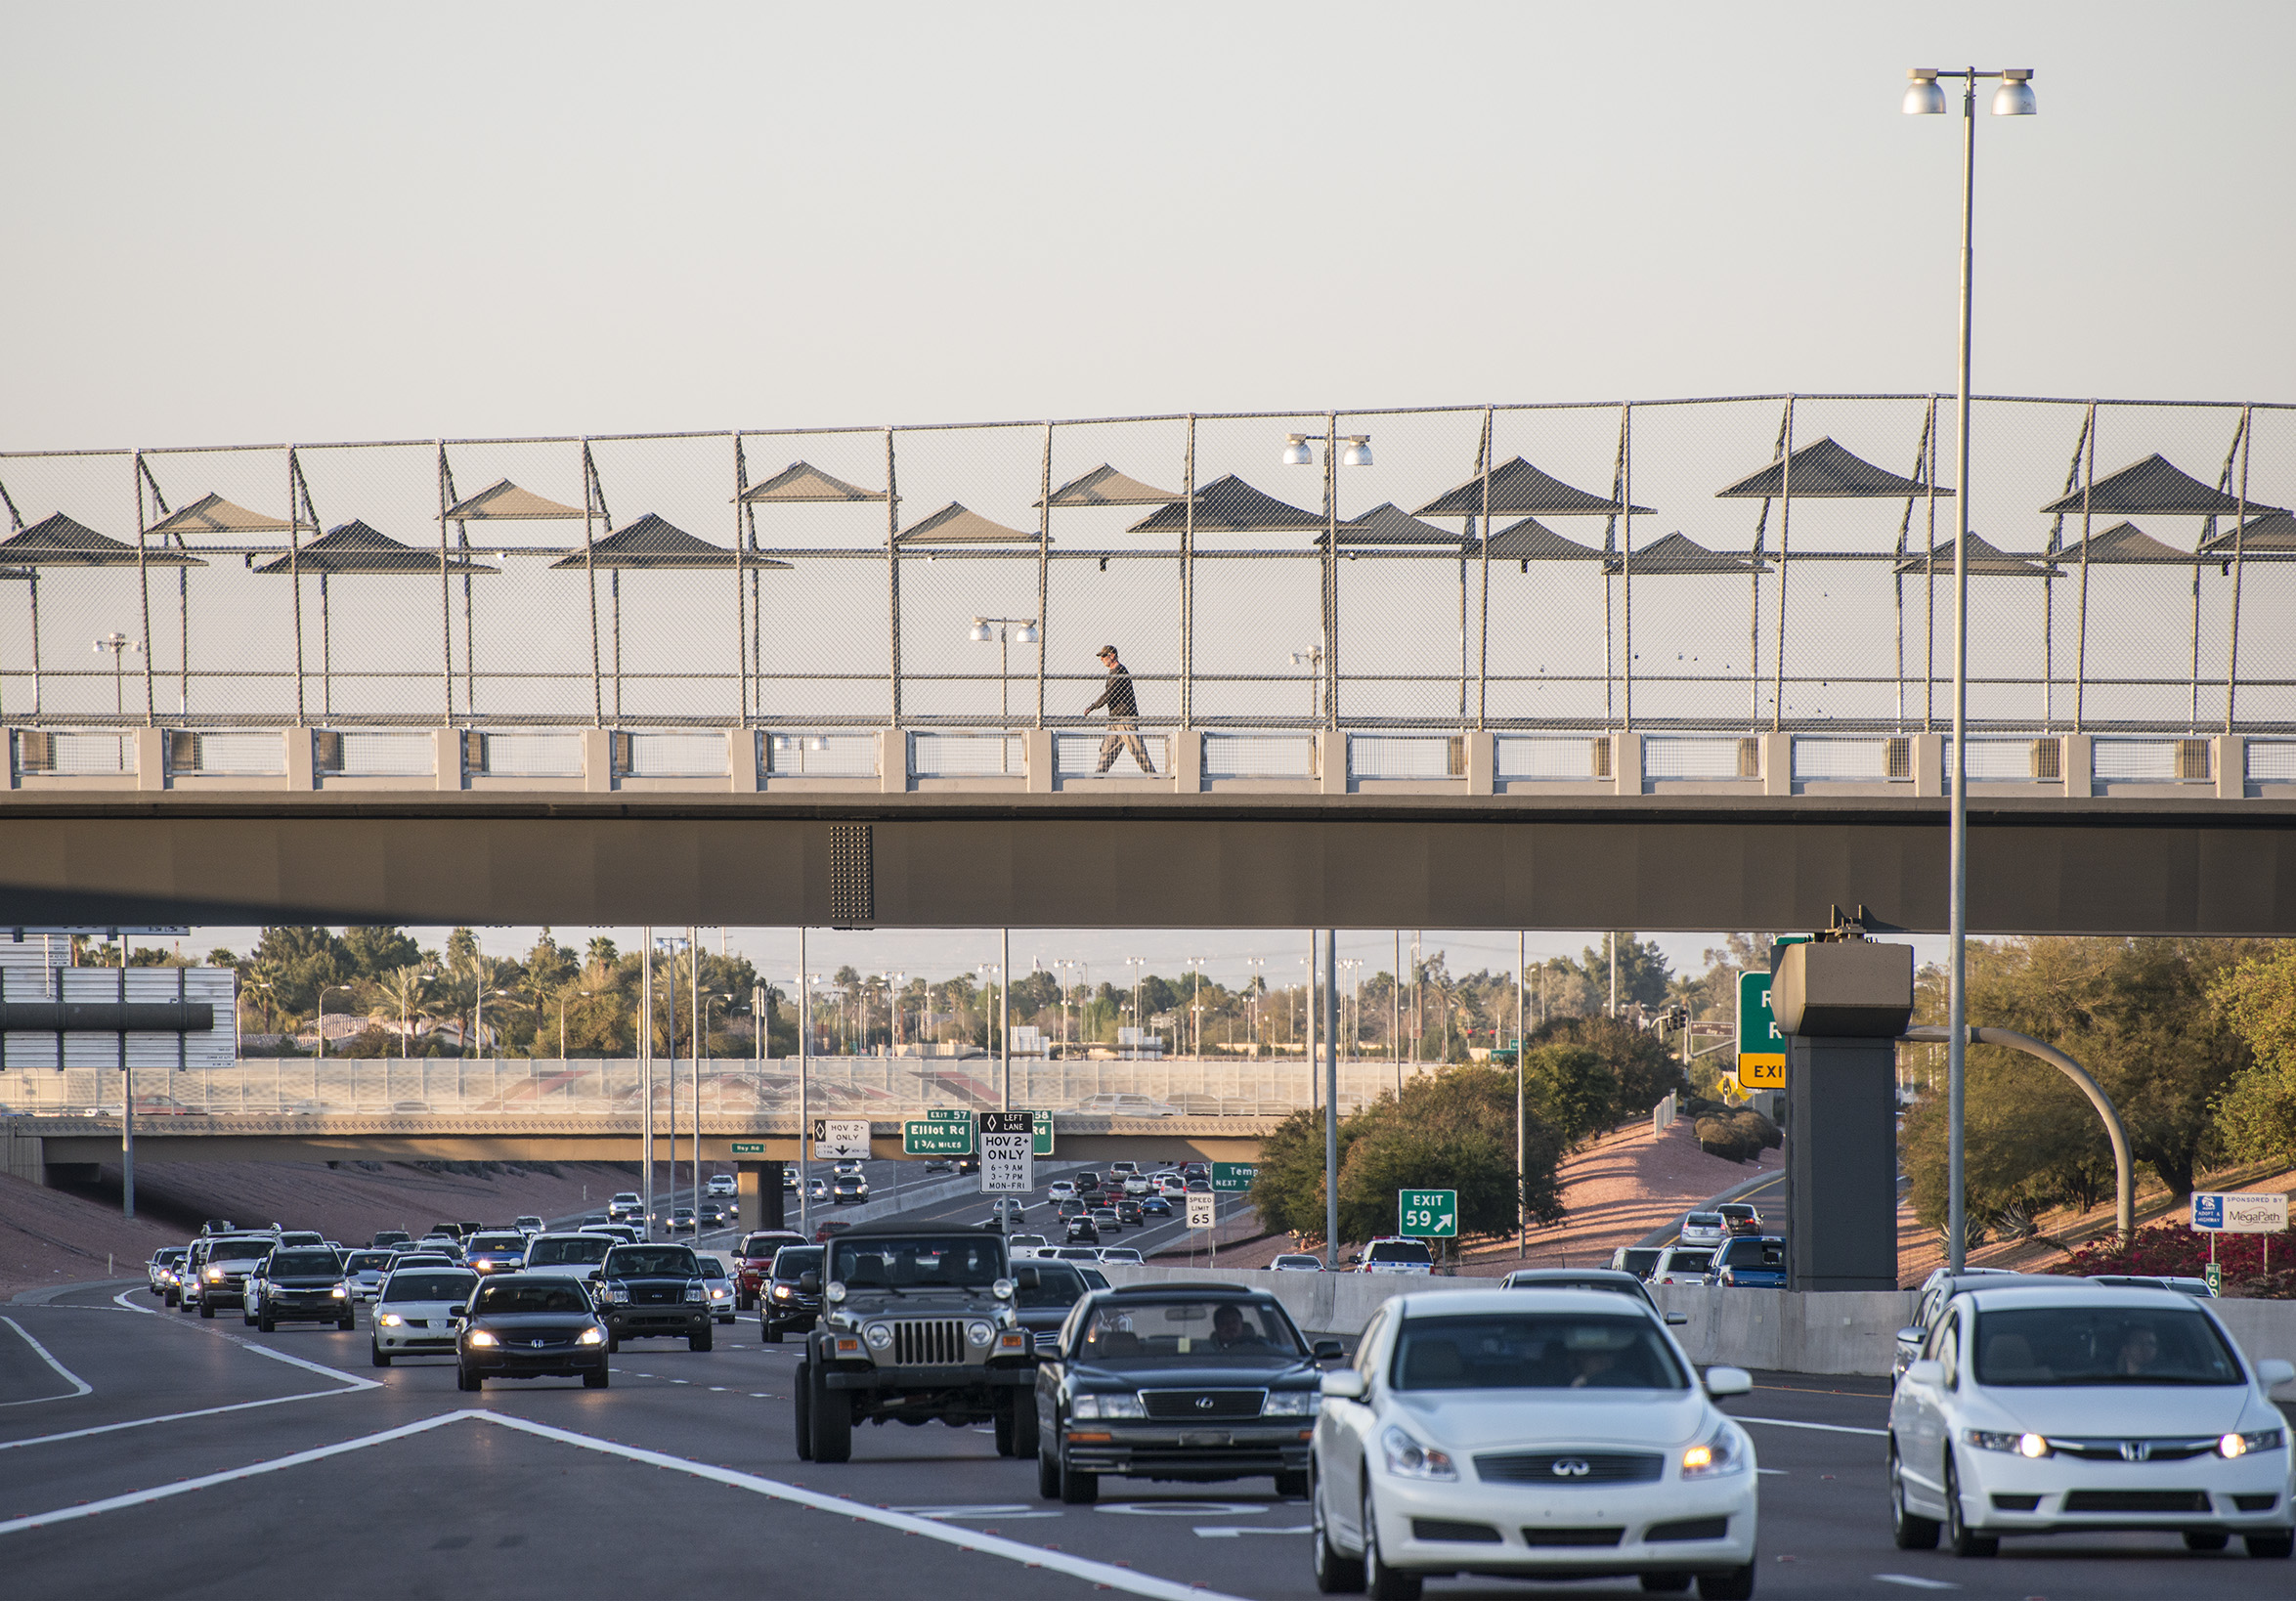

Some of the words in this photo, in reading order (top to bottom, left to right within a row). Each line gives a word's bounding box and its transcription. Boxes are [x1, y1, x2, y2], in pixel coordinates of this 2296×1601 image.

[1754, 1065, 1786, 1078] EXI
[953, 1110, 967, 1119] 57
[1034, 1110, 1049, 1119] 58
[911, 1125, 944, 1135] Elliot
[949, 1125, 965, 1135] Rd
[985, 1136, 1011, 1147] HOV
[1014, 1136, 1029, 1147] 2+
[988, 1149, 1024, 1160] ONLY
[1230, 1166, 1261, 1177] Temp
[1412, 1195, 1444, 1206] EXIT
[1191, 1213, 1209, 1224] 65
[1406, 1210, 1432, 1227] 59
[2229, 1211, 2280, 1223] MegaPath
